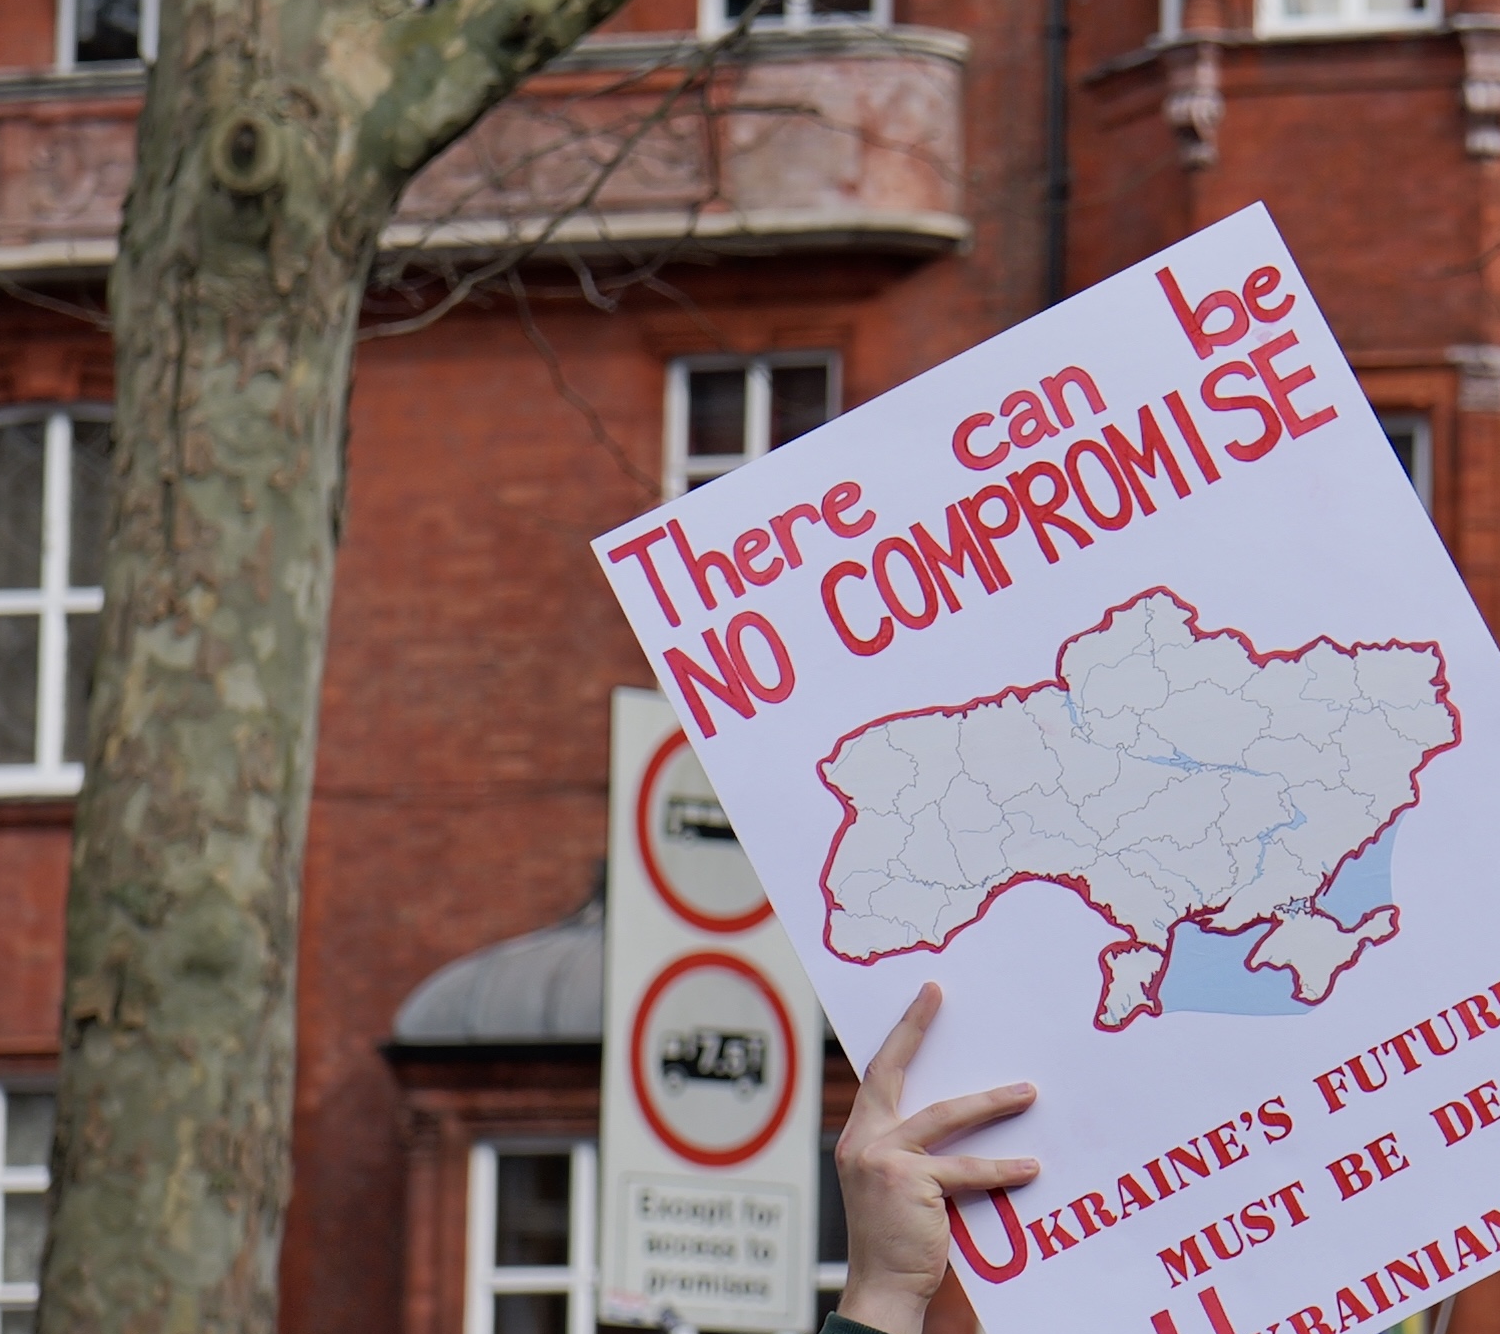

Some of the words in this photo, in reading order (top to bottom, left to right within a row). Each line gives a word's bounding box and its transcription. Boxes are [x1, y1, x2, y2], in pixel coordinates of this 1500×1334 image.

[607, 480, 877, 628] There
[952, 365, 1106, 472] can
[1156, 264, 1296, 360] be
[662, 610, 796, 739] NO
[820, 330, 1338, 657] COMPROMISE
[1156, 1180, 1309, 1287] MUST
[1326, 1131, 1411, 1202] BE
